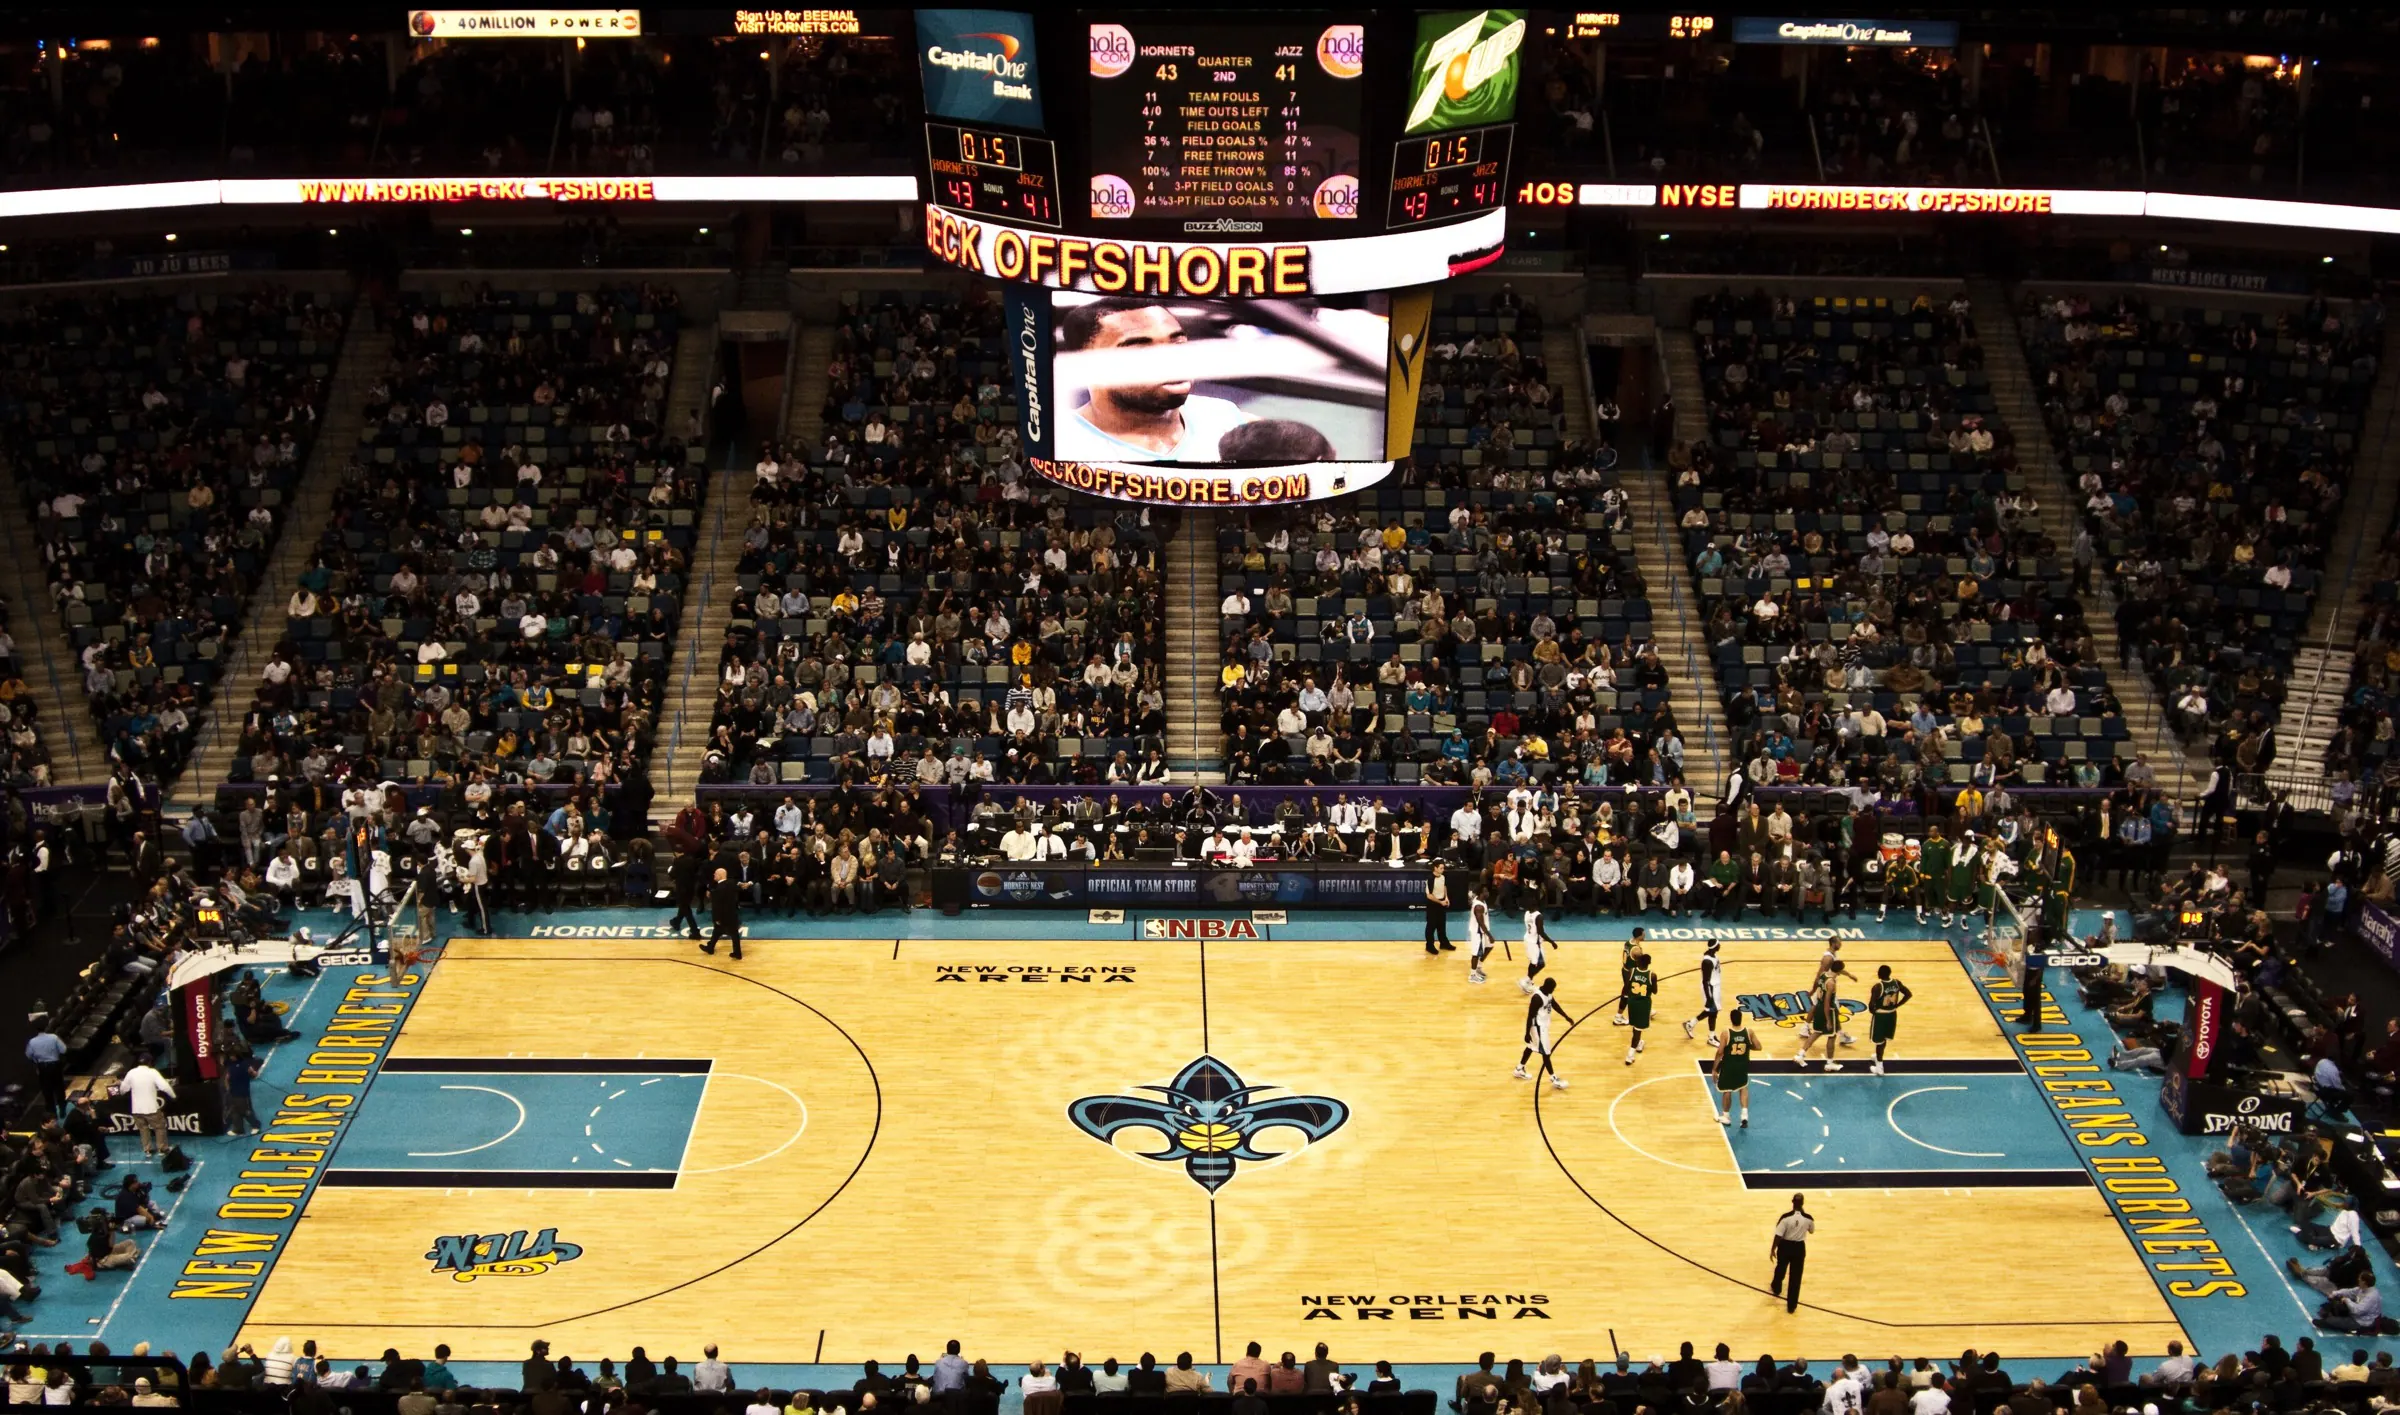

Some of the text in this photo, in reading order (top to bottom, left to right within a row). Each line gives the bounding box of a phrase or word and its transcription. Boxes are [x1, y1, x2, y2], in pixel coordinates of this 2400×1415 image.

[736, 10, 858, 22] Sign Up for BEEMAIL
[1576, 13, 1620, 24] HORNETS
[479, 16, 535, 29] MILLION
[735, 22, 859, 32] VISIT HORNETS.COM
[1671, 16, 1714, 30] 8:09
[1875, 29, 1912, 41] Bank
[1140, 46, 1195, 56] HORNETS
[1275, 46, 1303, 56] JAZZ
[1197, 56, 1252, 67] QUARTER
[1155, 63, 1178, 81] 43
[1213, 72, 1236, 82] 2ND
[1275, 63, 1296, 81] 41
[993, 80, 1033, 99] Bank
[1145, 92, 1157, 102] 11
[1189, 92, 1260, 102] TEAM FOULS
[1290, 92, 1296, 102] 7
[1180, 106, 1269, 116] TIME OUTS LEFT
[1147, 121, 1153, 131] 7
[1187, 121, 1261, 131] FIELD GOALS
[1285, 121, 1297, 131] 11
[1144, 136, 1170, 146] 36 %
[1182, 136, 1268, 146] FIELD GOALS %
[1284, 136, 1311, 146] 47 %
[1147, 151, 1154, 160] 7
[1184, 151, 1264, 160] FREE THROWS
[1285, 151, 1297, 160] 11
[932, 158, 978, 177] HORNETS
[1181, 166, 1267, 176] FREE THROW %
[1284, 166, 1311, 176] 85 %
[1472, 162, 1498, 178] JAZZ
[1017, 173, 1044, 188] JAZZ
[1147, 182, 1154, 191] 4
[1175, 182, 1274, 191] 3-PT FIELD GOALS
[1287, 182, 1294, 191] 0
[1394, 171, 1438, 191] HORNETS
[983, 183, 1004, 194] BONUS
[1440, 184, 1459, 196] BONUS
[1474, 181, 1497, 204] 41
[948, 181, 973, 209] 43
[1144, 196, 1168, 206] 44 %
[1168, 196, 1279, 206] 3-PT FIELD GOALS %
[1287, 196, 1310, 206] 0 %
[1661, 184, 1735, 207] NYSE
[1766, 187, 2051, 212] HORNBECK OFFSHORE
[1023, 193, 1049, 218] 41
[1405, 192, 1427, 219] 43
[993, 230, 1308, 295] OFFSHORE
[1088, 879, 1196, 892] OFFICIAL TEAM STORE
[1318, 879, 1362, 892] OFFICIAL
[1364, 879, 1392, 892] TEAM
[1168, 919, 1259, 938] NBA
[1649, 927, 1866, 940] HORNETS.COM
[317, 954, 372, 967] GEICO
[2048, 955, 2101, 966] GEICO
[936, 965, 1137, 973] NEW ORLEANS
[935, 974, 1136, 983] ARENA
[2200, 997, 2213, 1040] TOYOTA
[195, 994, 209, 1058] toyota.com
[109, 1112, 202, 1133] SPING
[2204, 1111, 2292, 1133] SPADING
[169, 972, 421, 1301] NEW ORLEANS HORNETS
[2013, 1033, 2149, 1147] ORLEANS
[2090, 1156, 2249, 1299] HORNETS
[1301, 1294, 1550, 1306] NEW ORLEANS
[1303, 1307, 1552, 1320] ARENA
